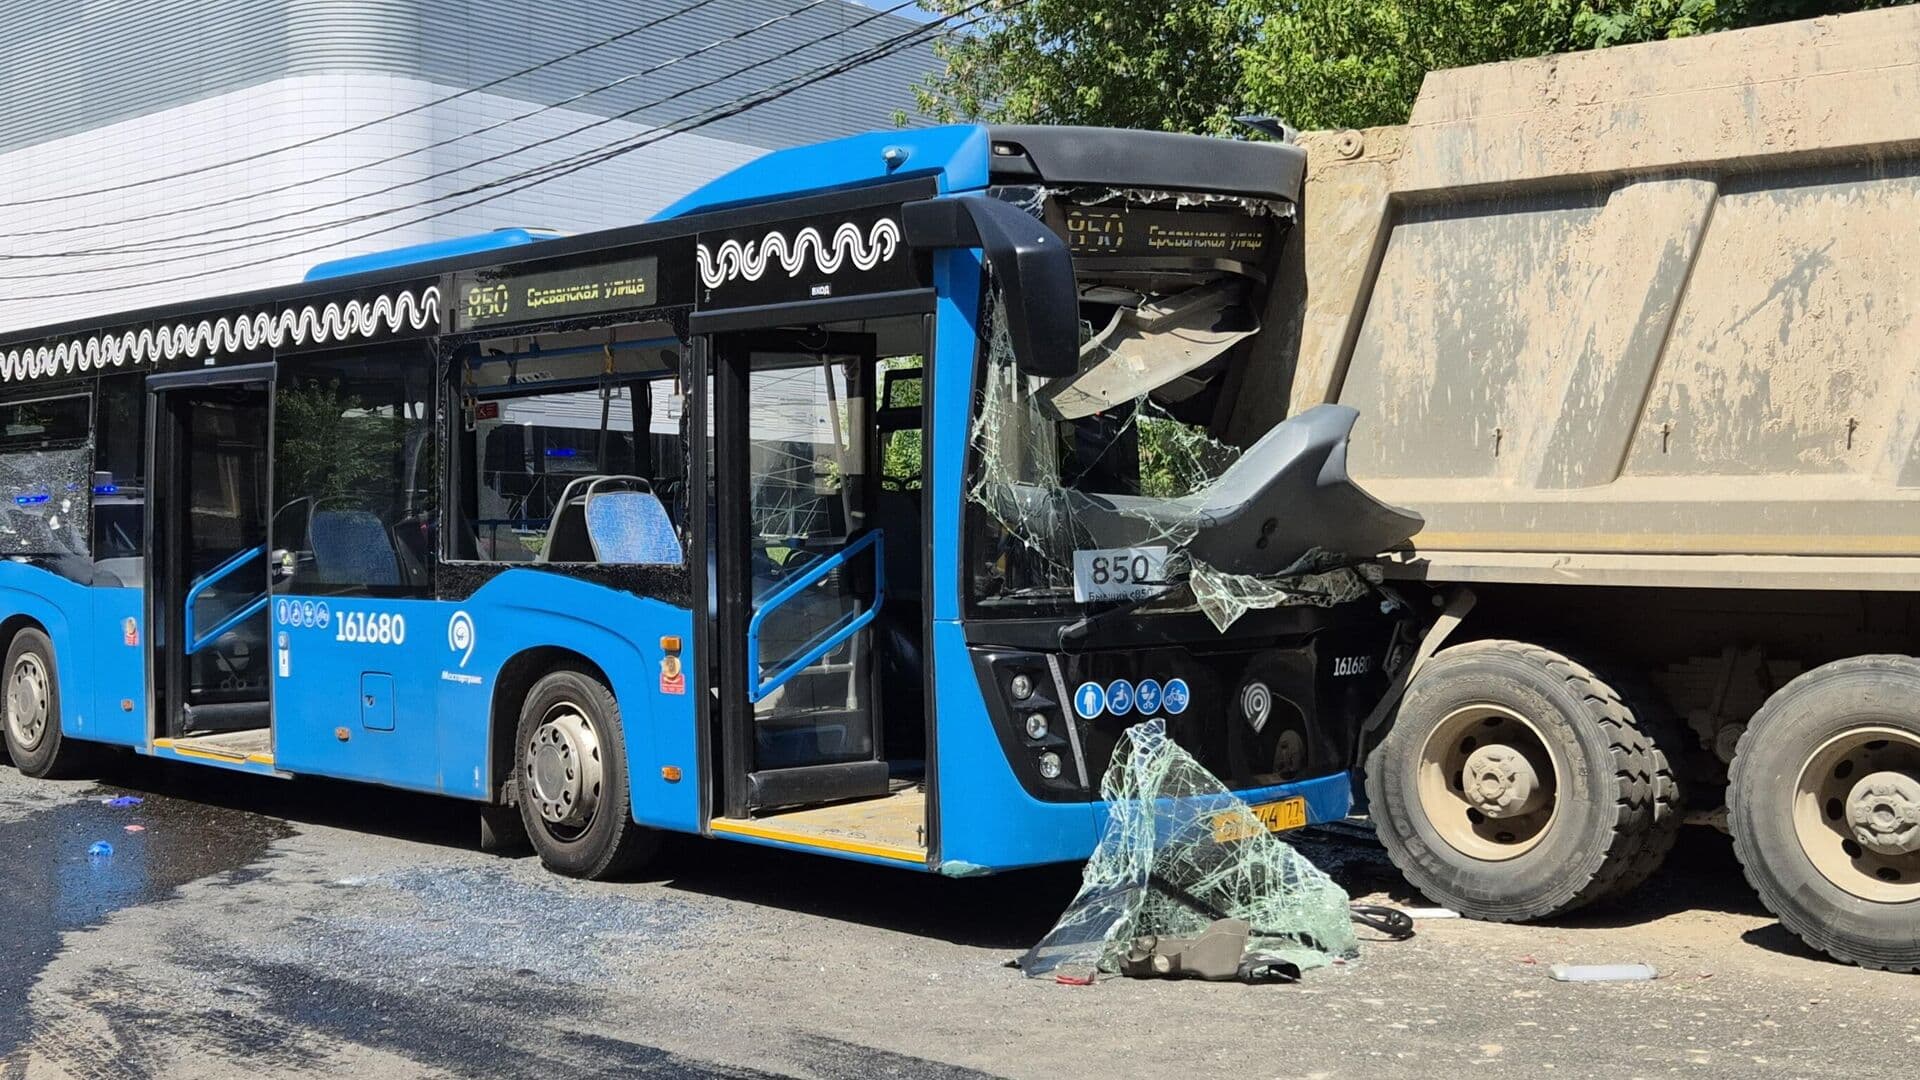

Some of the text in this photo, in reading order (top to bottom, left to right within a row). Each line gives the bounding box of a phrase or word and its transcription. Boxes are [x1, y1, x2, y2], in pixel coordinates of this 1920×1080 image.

[1067, 211, 1123, 252] 850
[468, 278, 645, 320] 850 Ереванская улица
[1092, 555, 1149, 585] 850
[336, 611, 405, 645] 161680
[1286, 801, 1300, 818] 77
